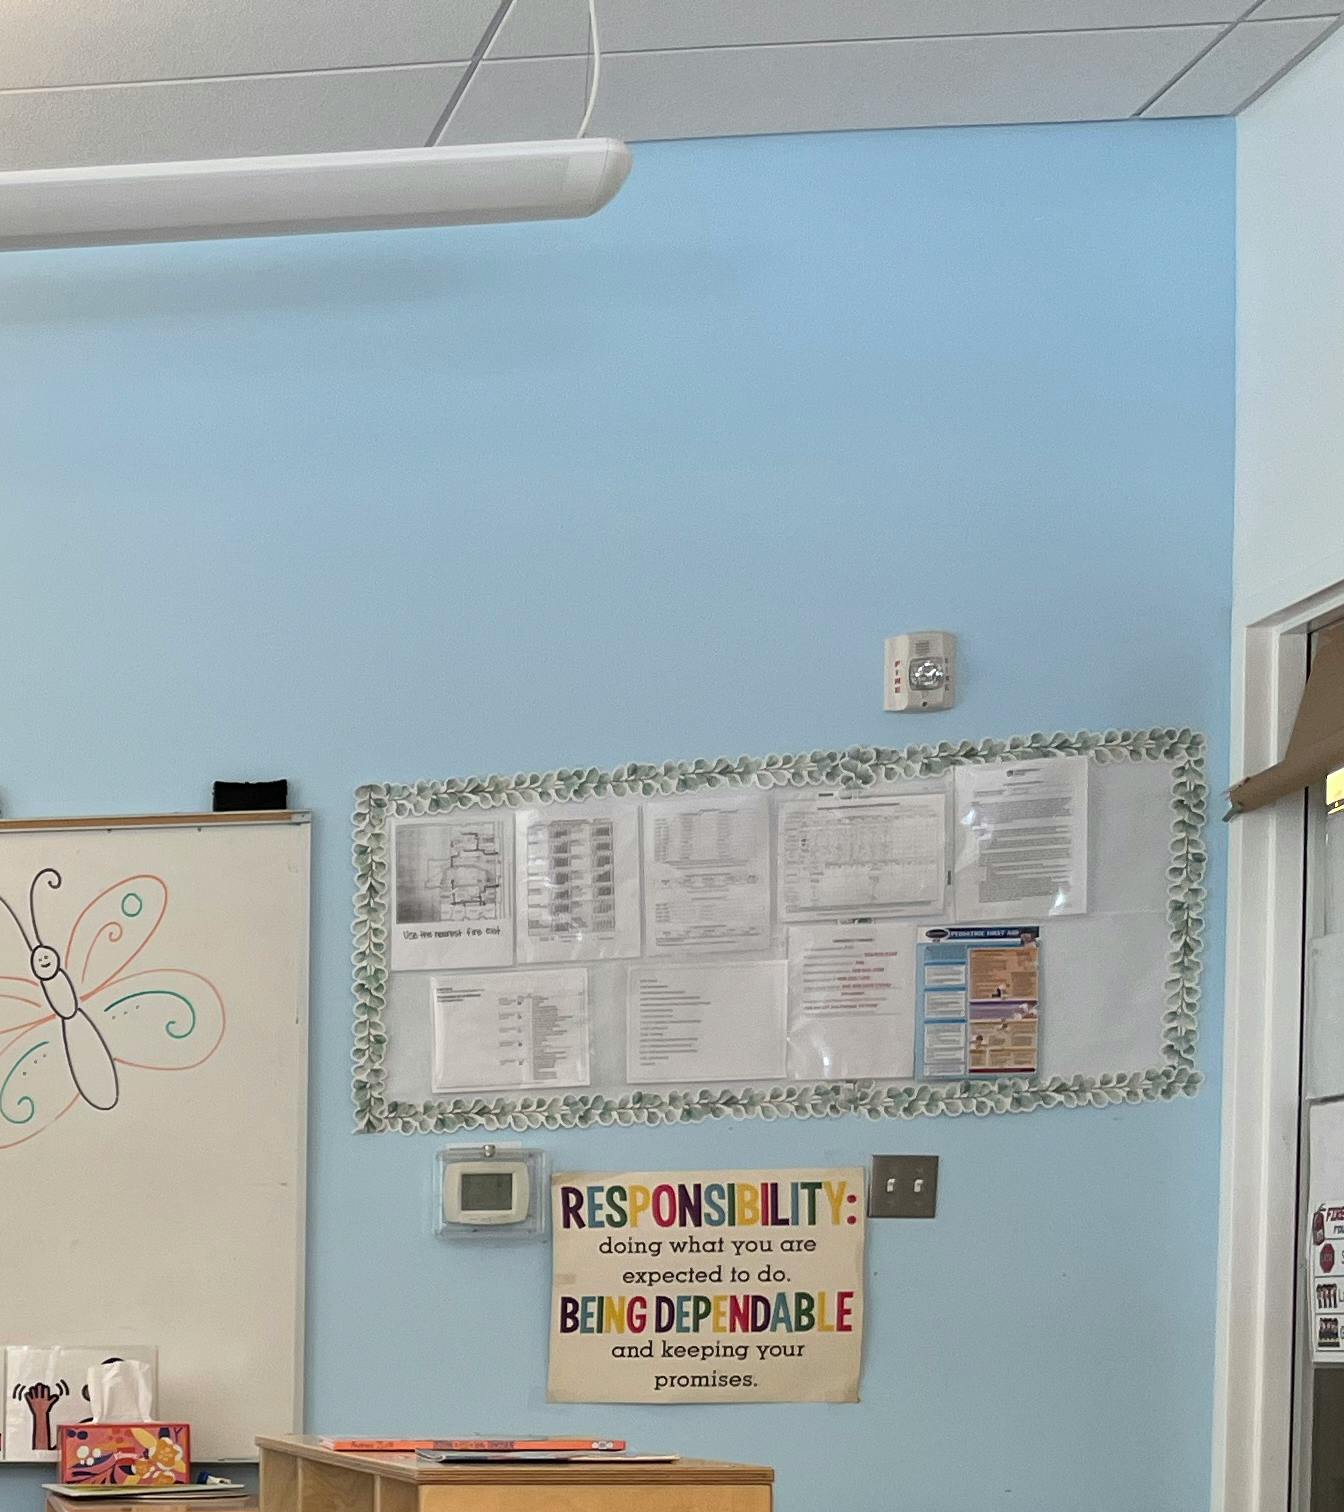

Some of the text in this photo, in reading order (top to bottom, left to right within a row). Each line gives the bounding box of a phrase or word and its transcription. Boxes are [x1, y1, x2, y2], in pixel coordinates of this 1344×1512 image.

[560, 1181, 857, 1229] RESPONSIBILITY:
[599, 1236, 816, 1257] doing what you are
[622, 1266, 791, 1287] expected to do.
[560, 1292, 854, 1334] BEING DEPENDABLE
[611, 1340, 806, 1361] and keeping your
[654, 1371, 758, 1390] promises.
